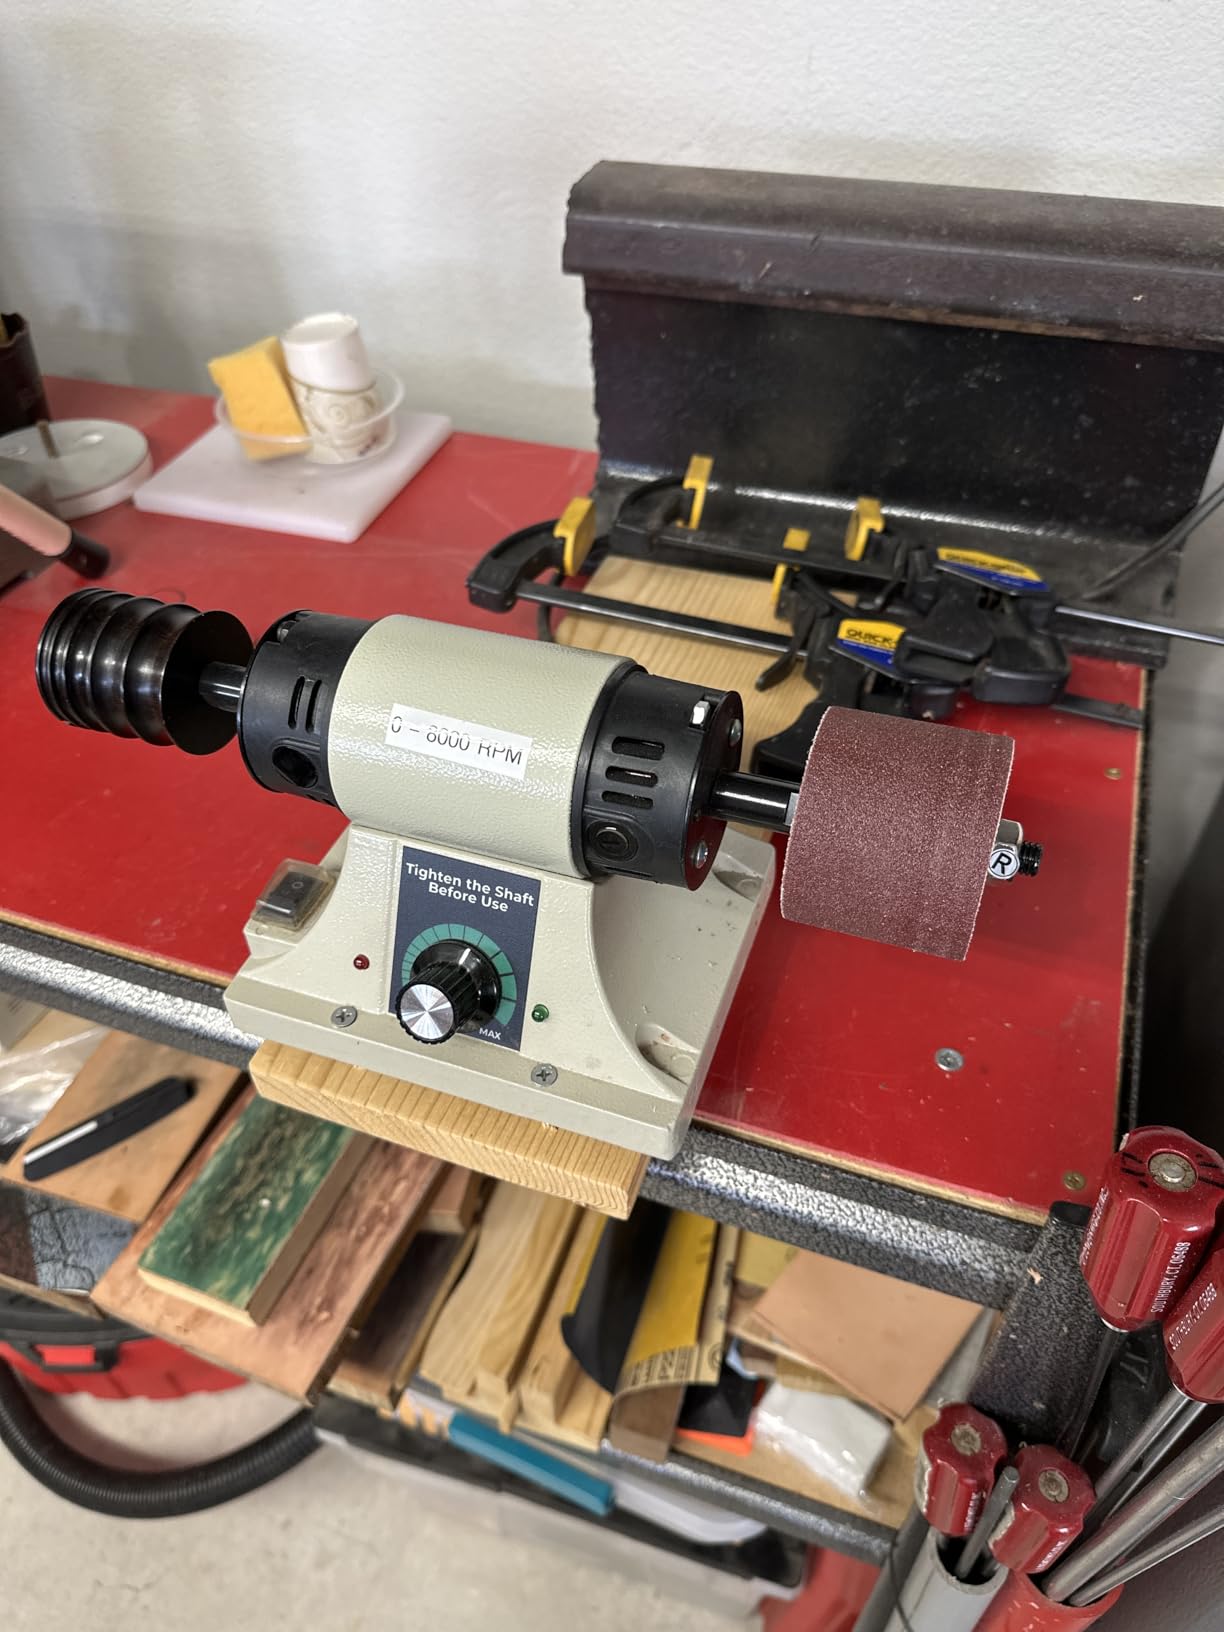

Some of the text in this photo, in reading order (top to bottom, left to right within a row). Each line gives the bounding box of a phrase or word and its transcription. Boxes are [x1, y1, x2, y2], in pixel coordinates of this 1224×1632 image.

[391, 716, 402, 733] 0
[477, 738, 522, 765] RPM
[406, 862, 535, 906] Tighten the Shaft
[428, 881, 509, 912] Before Use
[479, 1027, 502, 1041] MAX
